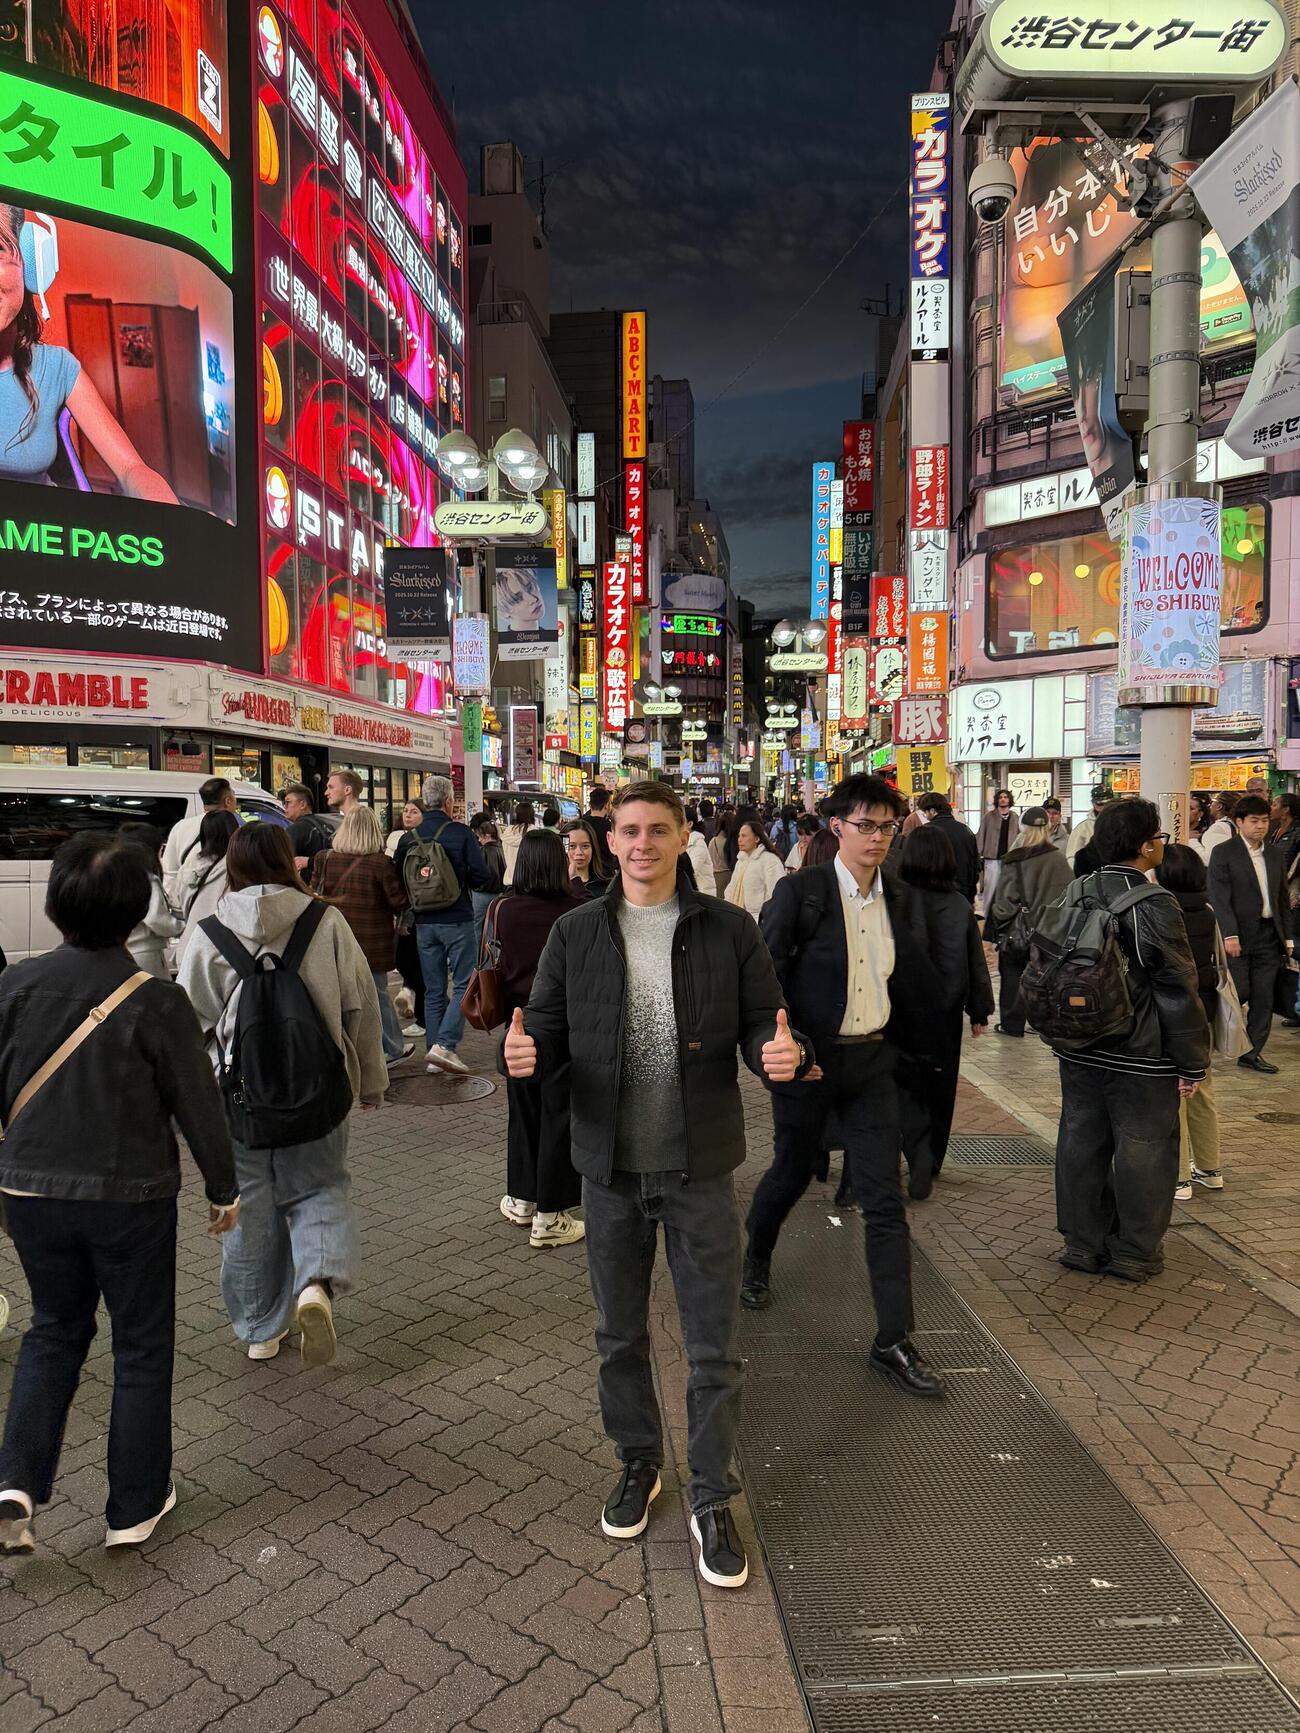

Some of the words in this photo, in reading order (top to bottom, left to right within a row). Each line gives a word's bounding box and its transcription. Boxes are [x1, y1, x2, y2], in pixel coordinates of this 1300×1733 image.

[1001, 16, 1270, 52] 渋谷センター街
[914, 96, 947, 106] プリンスビル
[1234, 146, 1284, 205] Starkissed
[915, 129, 946, 262] カラオケ
[920, 260, 938, 271] Ban
[926, 265, 943, 277] Ban
[916, 285, 929, 345] ルノアール
[922, 350, 937, 359] 2F
[858, 428, 871, 481] お好み焼
[845, 456, 858, 507] もんじゃ
[915, 449, 933, 527] 野郎ラーメン
[1023, 485, 1056, 511] 喫茶室
[440, 512, 540, 525] 渋谷センター街
[0, 520, 64, 556] ME
[72, 528, 164, 567] PASS
[844, 533, 856, 569] 無呼吸
[858, 532, 870, 568] いびき
[390, 572, 442, 590] Starkissed
[1137, 551, 1220, 594] WELCOME
[607, 563, 627, 646] カラオケ
[1134, 598, 1154, 612] TO
[1156, 593, 1221, 612] SHIBUYA
[0, 604, 223, 641] されている一部のゲームは近日登場です。
[848, 623, 862, 631] B1F
[583, 687, 593, 696] 2F
[606, 669, 628, 728] 歌広場
[12, 708, 81, 717] DELICIOUS
[584, 720, 593, 740] 松屋
[898, 700, 942, 741] 豚
[967, 714, 1007, 732] 喫茶室
[551, 738, 562, 747] B1
[909, 750, 934, 794] 野郎
